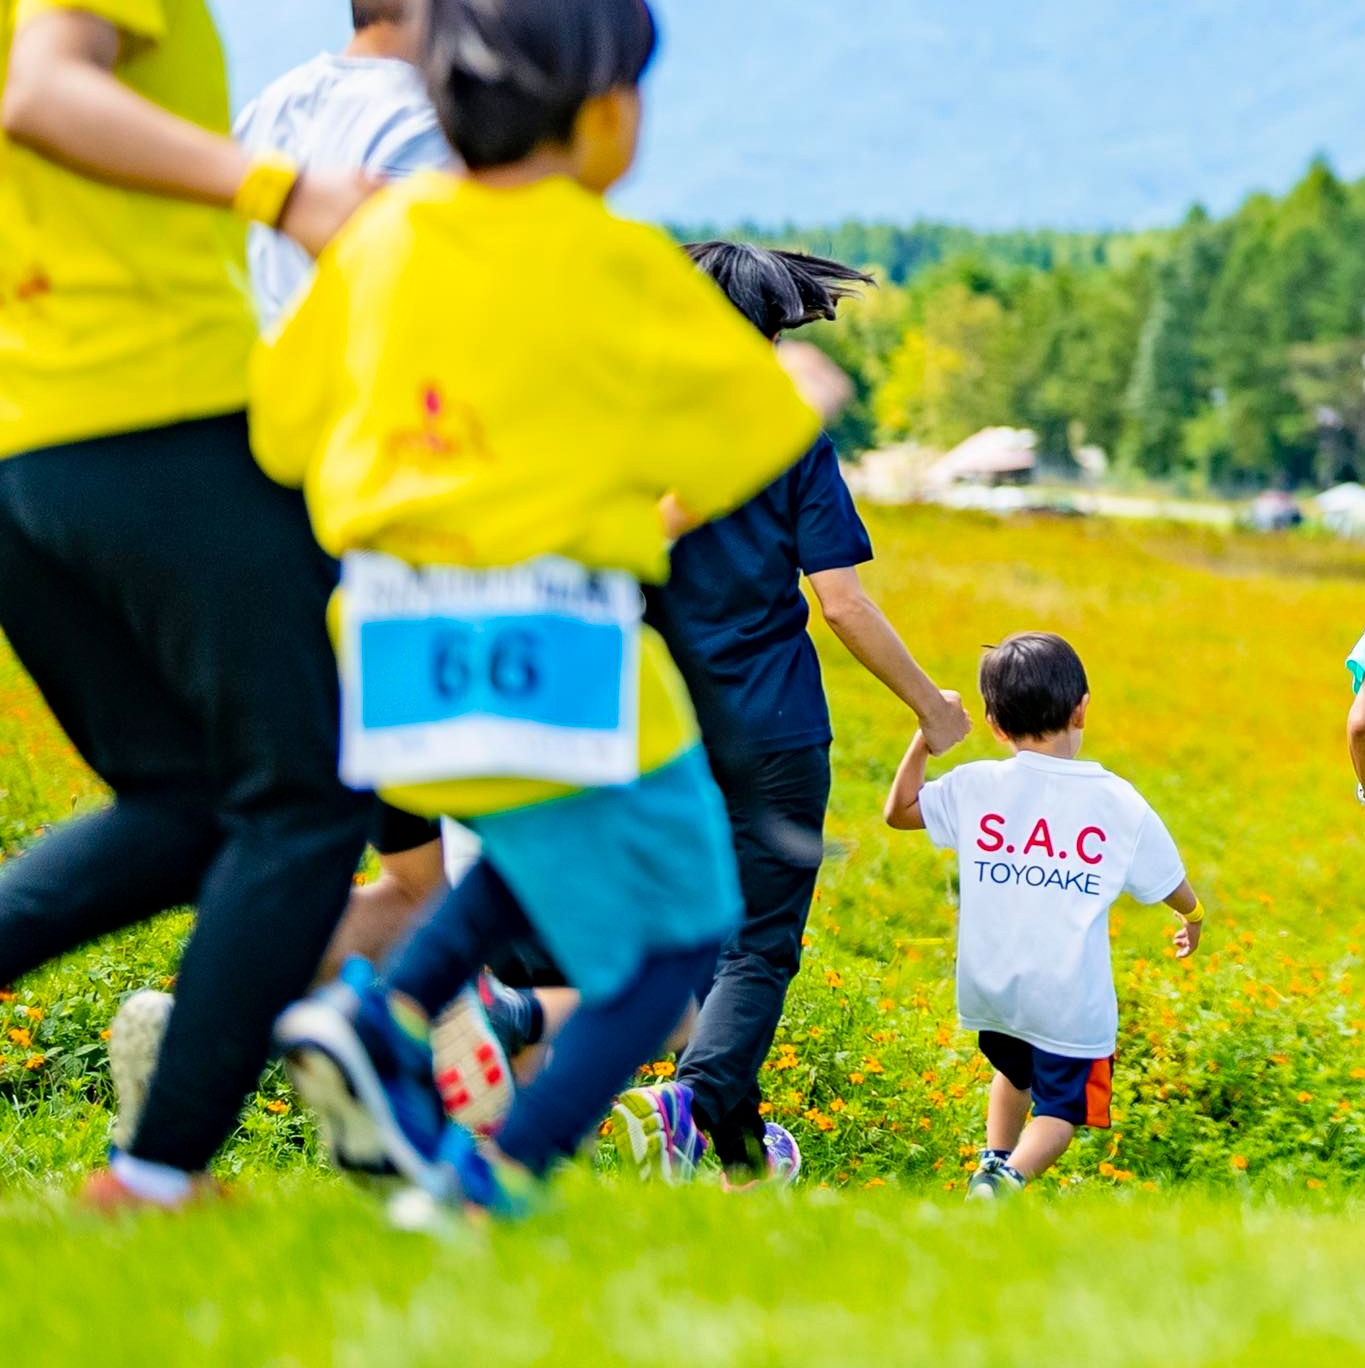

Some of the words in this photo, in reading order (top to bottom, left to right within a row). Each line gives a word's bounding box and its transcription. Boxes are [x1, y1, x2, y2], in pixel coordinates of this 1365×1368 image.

[430, 627, 541, 704] 66
[976, 813, 1106, 865] S.A.C
[974, 860, 1101, 895] TOYOAKE
